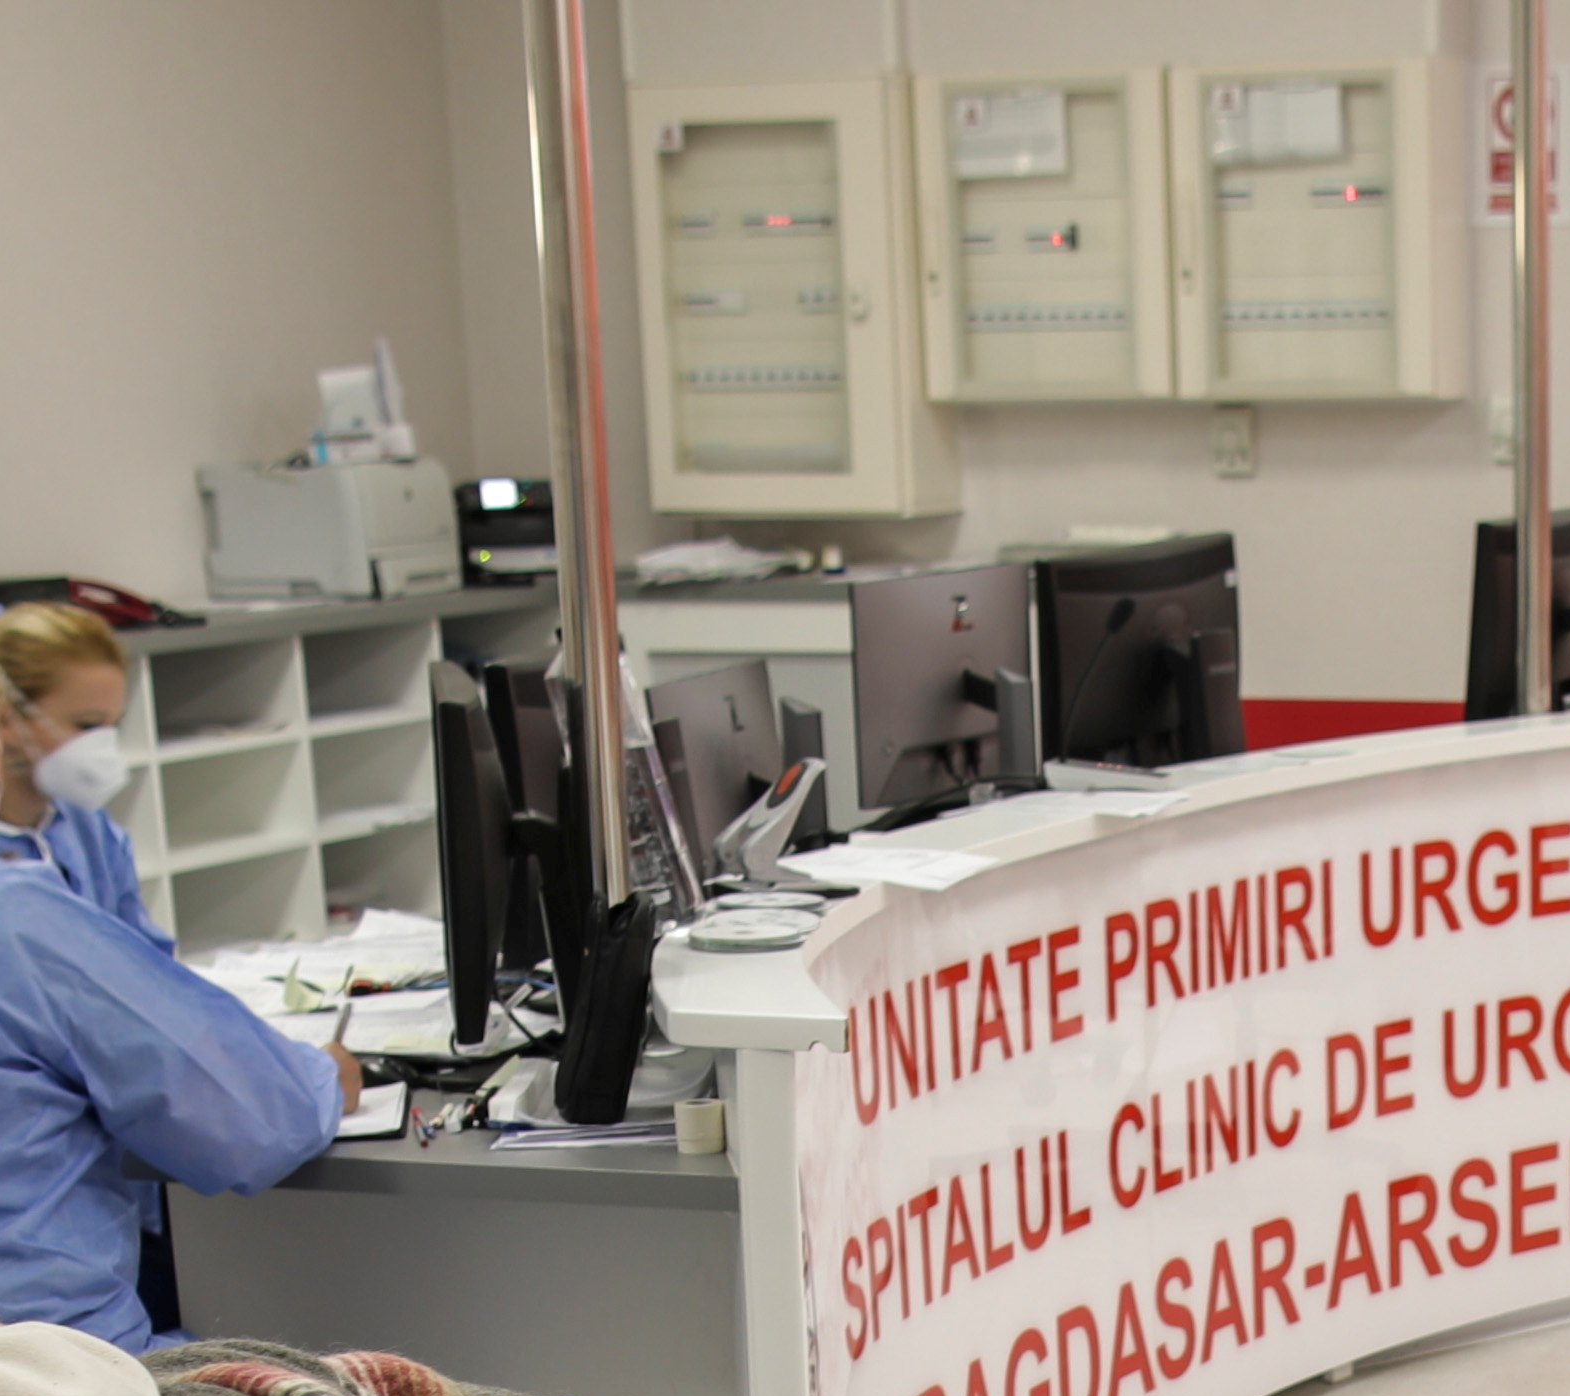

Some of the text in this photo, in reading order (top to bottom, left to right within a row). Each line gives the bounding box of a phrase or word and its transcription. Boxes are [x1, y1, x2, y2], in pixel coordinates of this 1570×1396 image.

[846, 924, 1085, 1126] UNITATE
[1104, 859, 1335, 1023] PRIMIRI
[842, 1130, 1093, 1361] SPITALUL
[1108, 1047, 1303, 1210] CLINIC
[1325, 1017, 1416, 1132] DE
